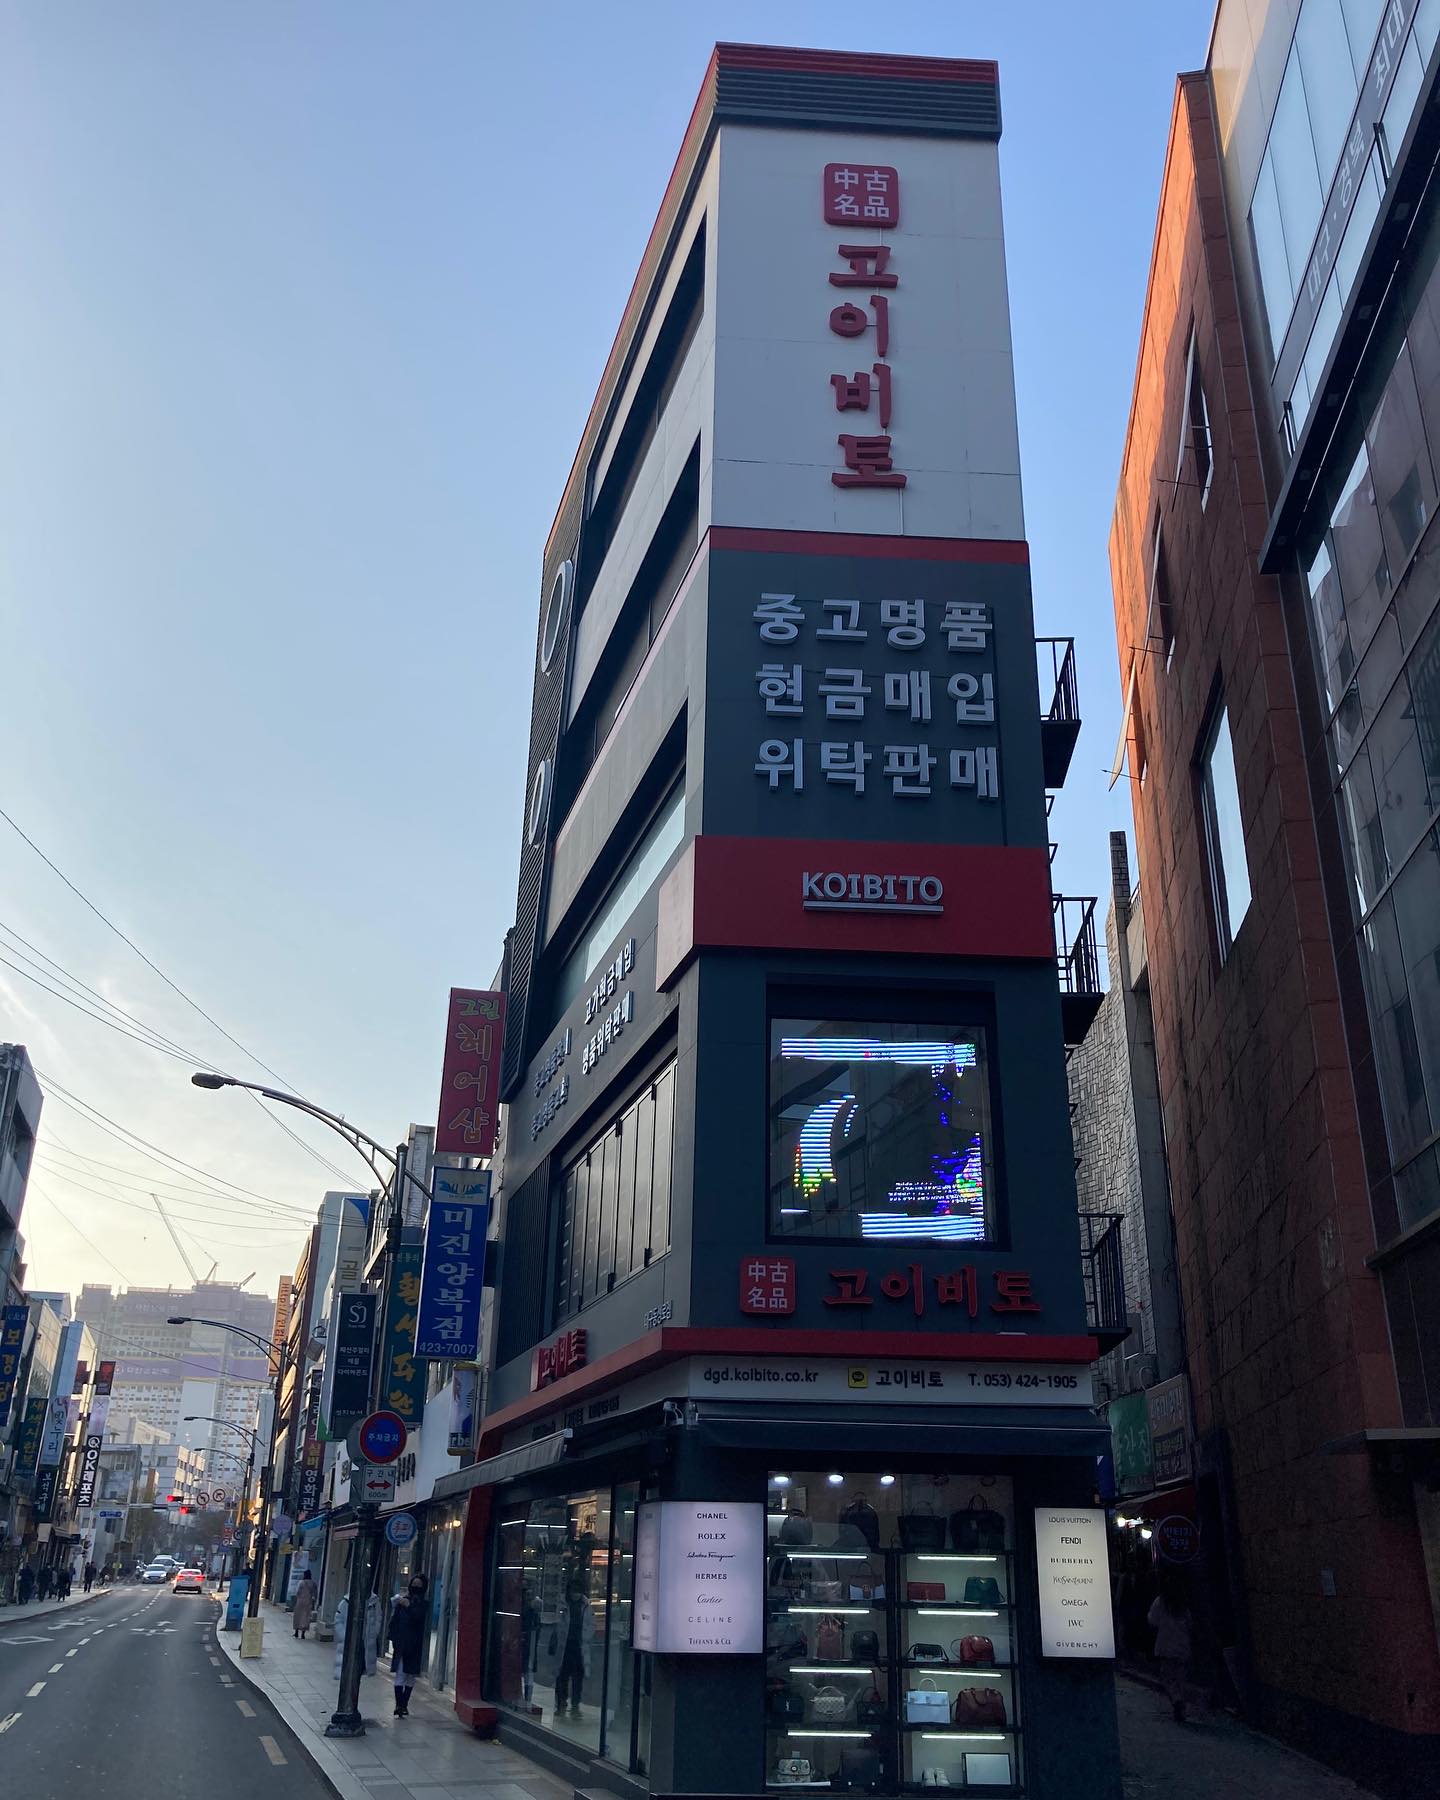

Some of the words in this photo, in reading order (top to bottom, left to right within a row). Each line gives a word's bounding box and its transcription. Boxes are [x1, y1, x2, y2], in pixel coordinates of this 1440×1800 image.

[834, 168, 890, 193] 中古
[833, 194, 890, 218] 名品
[829, 244, 907, 489] 고이비토
[753, 592, 993, 653] 중고명품
[755, 663, 996, 726] 현금매입
[754, 738, 999, 800] 위탁판매
[802, 871, 944, 903] KOIBITO
[432, 1207, 475, 1340] 미진양복점
[747, 1261, 789, 1284] 中古
[747, 1287, 789, 1309] 名品
[823, 1264, 1041, 1318] 고이비토
[419, 1341, 475, 1355] 423-7007
[703, 1367, 819, 1384] dgd.koibito.co.kr
[876, 1369, 944, 1388] 고이비토
[984, 1374, 1012, 1388] 053)
[1016, 1375, 1078, 1389] 424-1905
[1060, 1537, 1082, 1545] FENDI
[1050, 1557, 1093, 1565] BURBERRY
[697, 1593, 724, 1604] Cartier
[1061, 1599, 1088, 1607] OMEGA
[1068, 1619, 1084, 1628] IWC
[688, 1637, 713, 1645] TIFFANY
